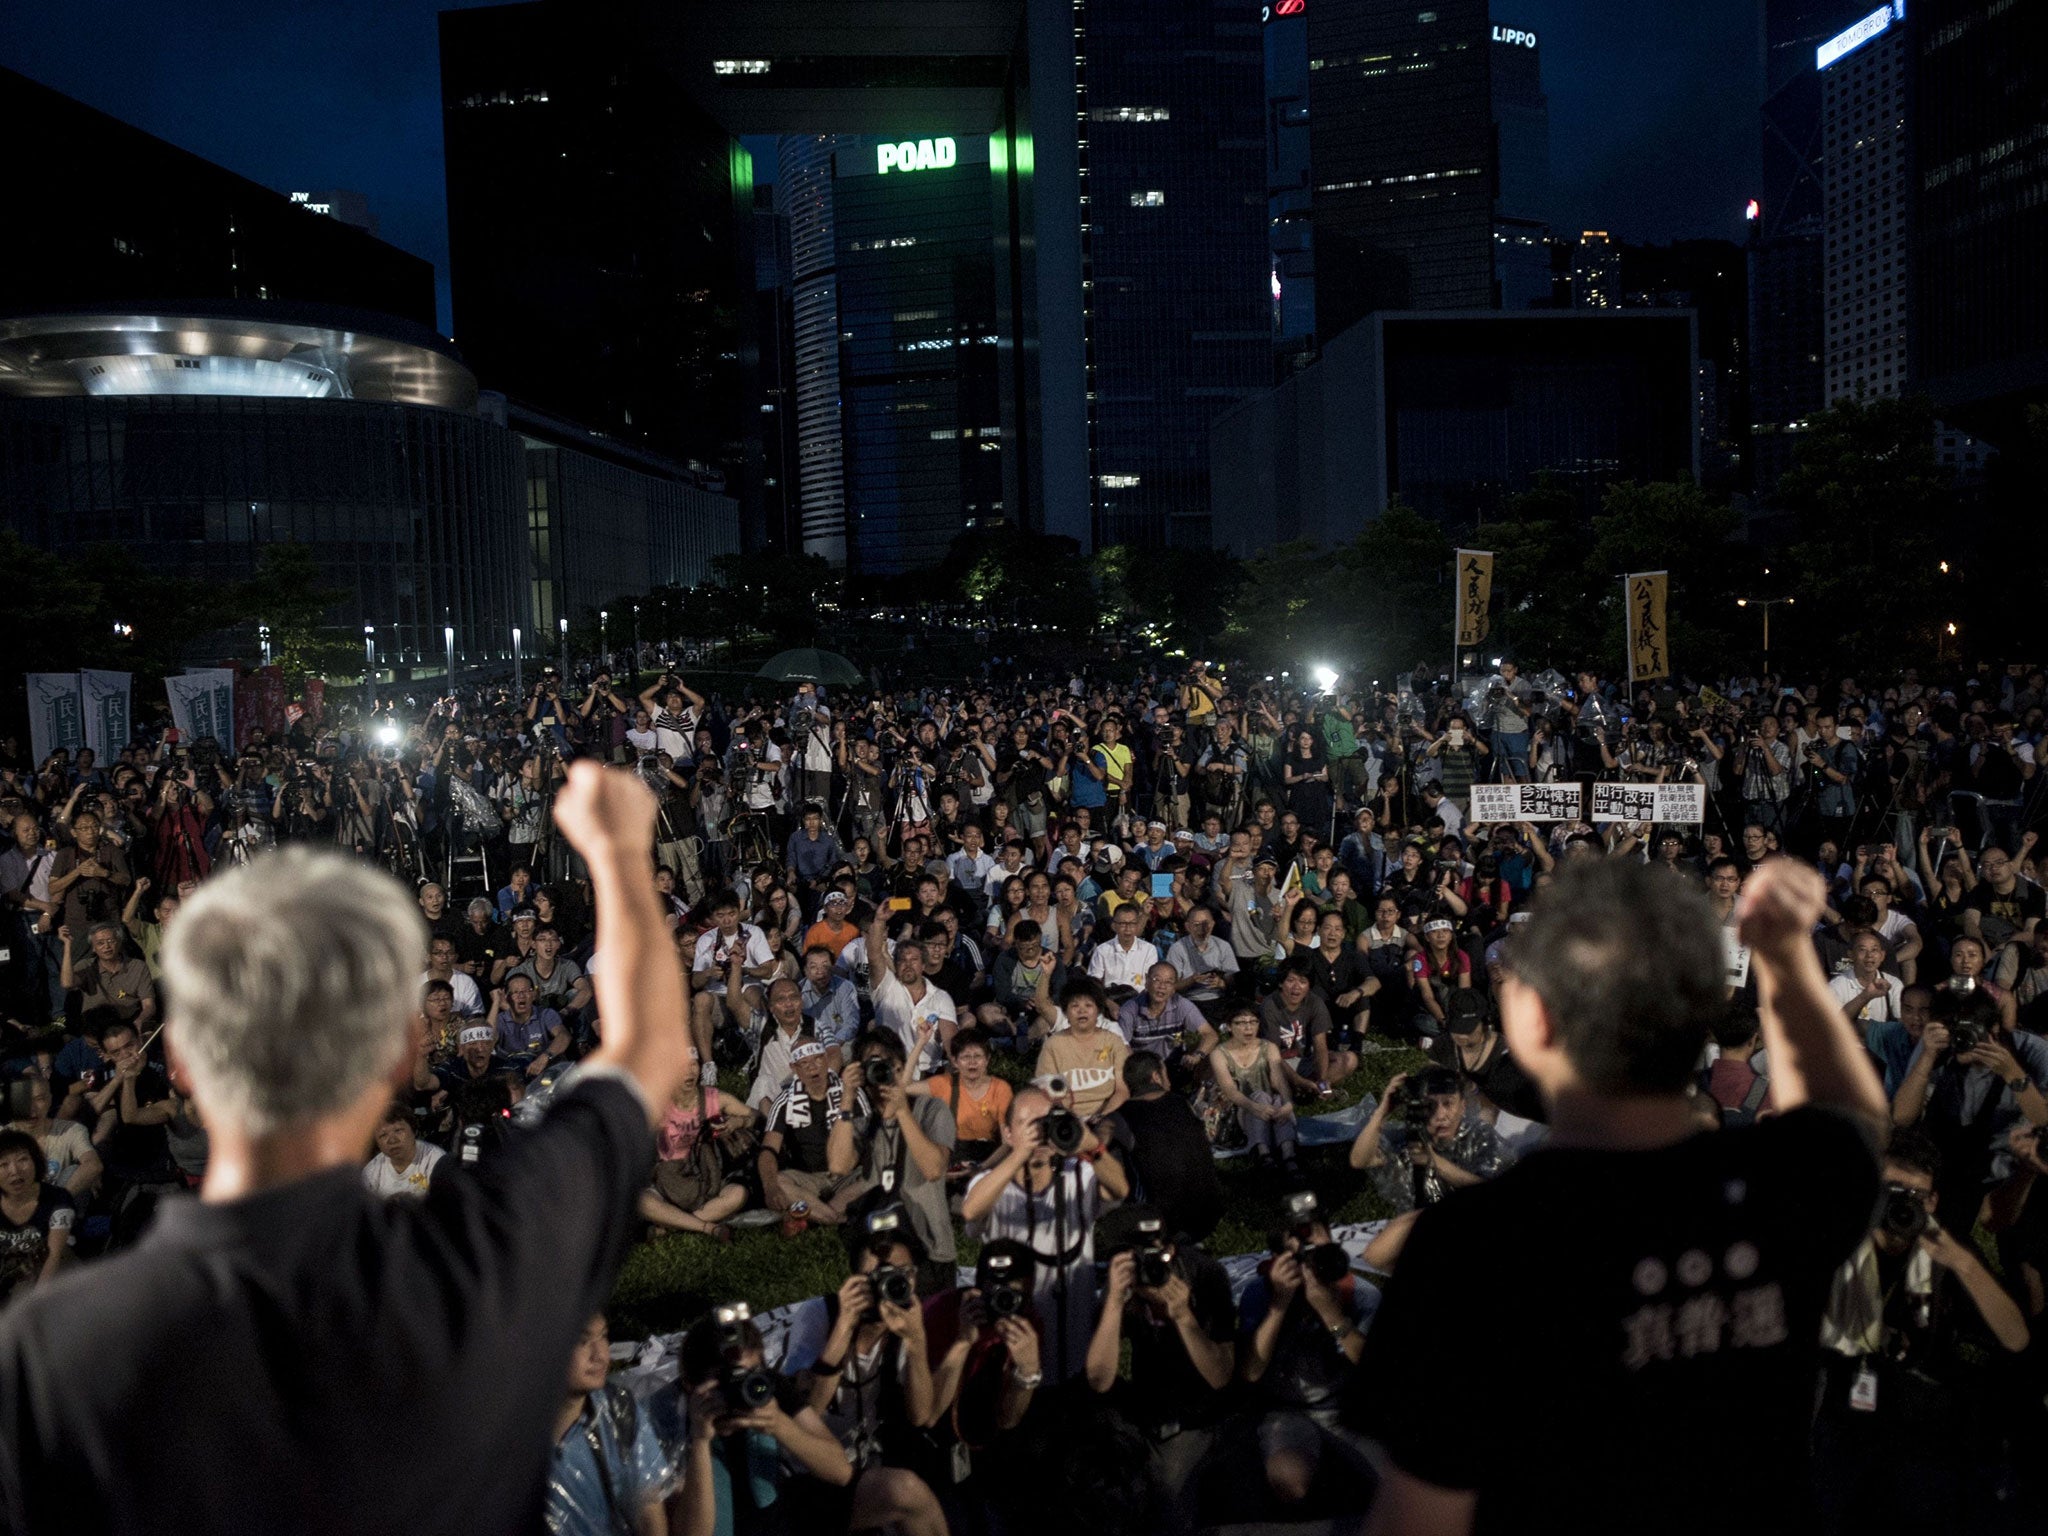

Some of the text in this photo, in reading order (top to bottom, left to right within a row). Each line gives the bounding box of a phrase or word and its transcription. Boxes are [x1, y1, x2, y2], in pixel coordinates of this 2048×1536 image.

[1492, 26, 1536, 48] LIPPO
[877, 137, 957, 175] POAD
[290, 192, 310, 202] JW
